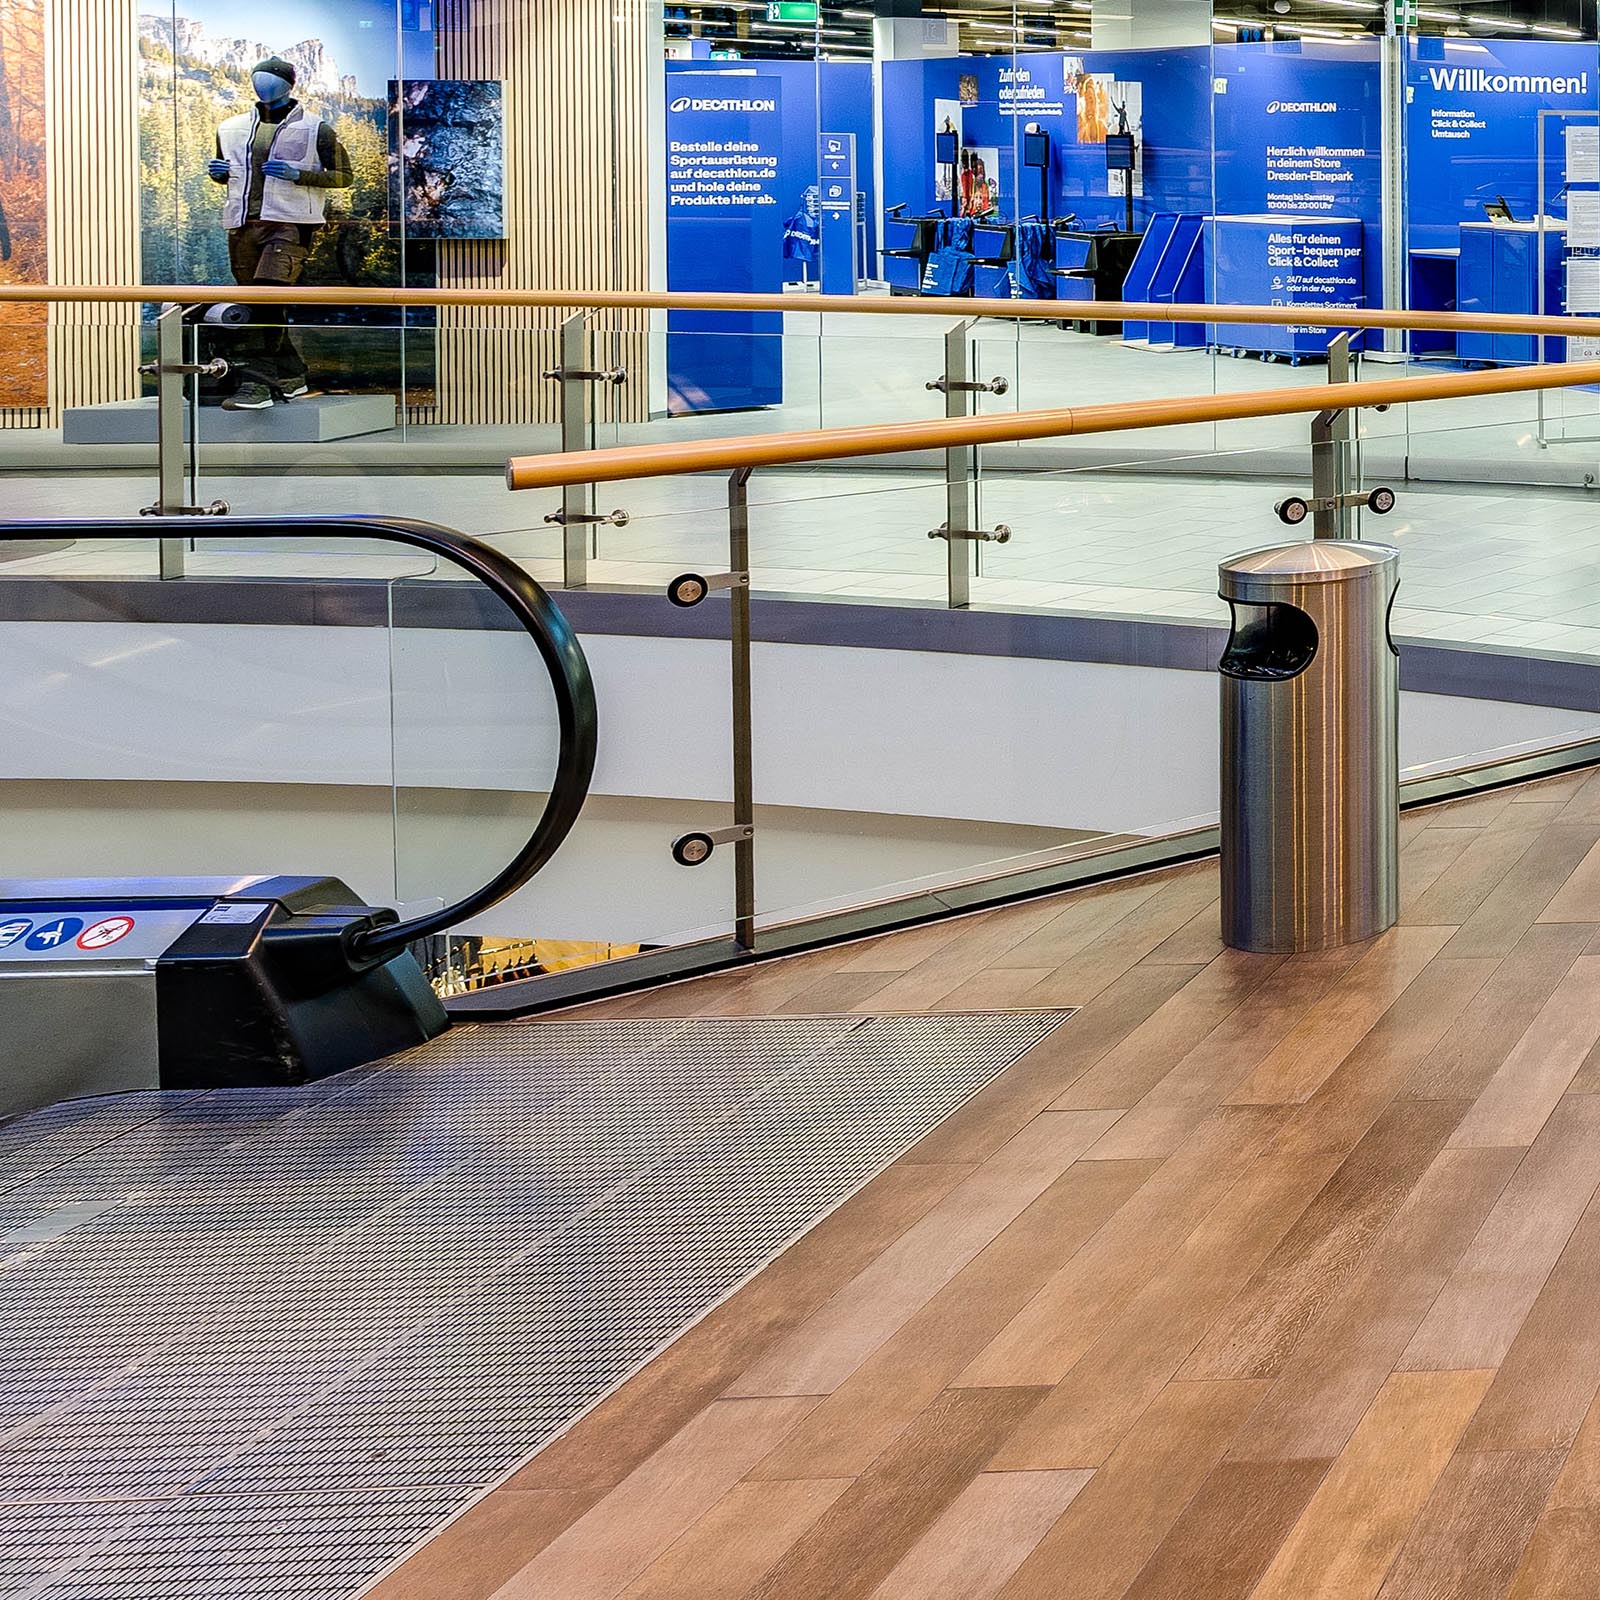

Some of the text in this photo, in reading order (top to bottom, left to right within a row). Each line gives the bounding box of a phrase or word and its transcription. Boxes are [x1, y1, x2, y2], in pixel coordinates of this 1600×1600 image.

[1429, 67, 1588, 94] Willkommen!
[691, 99, 775, 111] DECATHLON
[1280, 103, 1337, 112] DECATHLON
[1431, 109, 1475, 118] Information
[1431, 119, 1486, 128] Click & Collect
[1431, 129, 1470, 138] Umtausch
[670, 141, 759, 152] Bestelle deine
[1266, 146, 1365, 156] Herzlich willkommen
[670, 155, 777, 167] Sportausrüstung
[1266, 158, 1340, 167] in deinem Store
[670, 168, 776, 179] auf decathlon.de
[1267, 171, 1353, 182] Dresden-Elbepark
[670, 182, 761, 192] und hole deine
[670, 194, 777, 206] Produkte hier ab.
[1267, 193, 1334, 202] Montag bis Samstag
[1268, 233, 1341, 244] Alles für deinen
[1268, 245, 1296, 257] Sport
[1303, 246, 1343, 257] bequem
[1344, 248, 1361, 258] per
[1268, 257, 1338, 267] Click & Collect
[1286, 276, 1357, 284] 24/7 auf decathlon.de
[1321, 285, 1335, 293] App
[1308, 326, 1327, 334] Store
